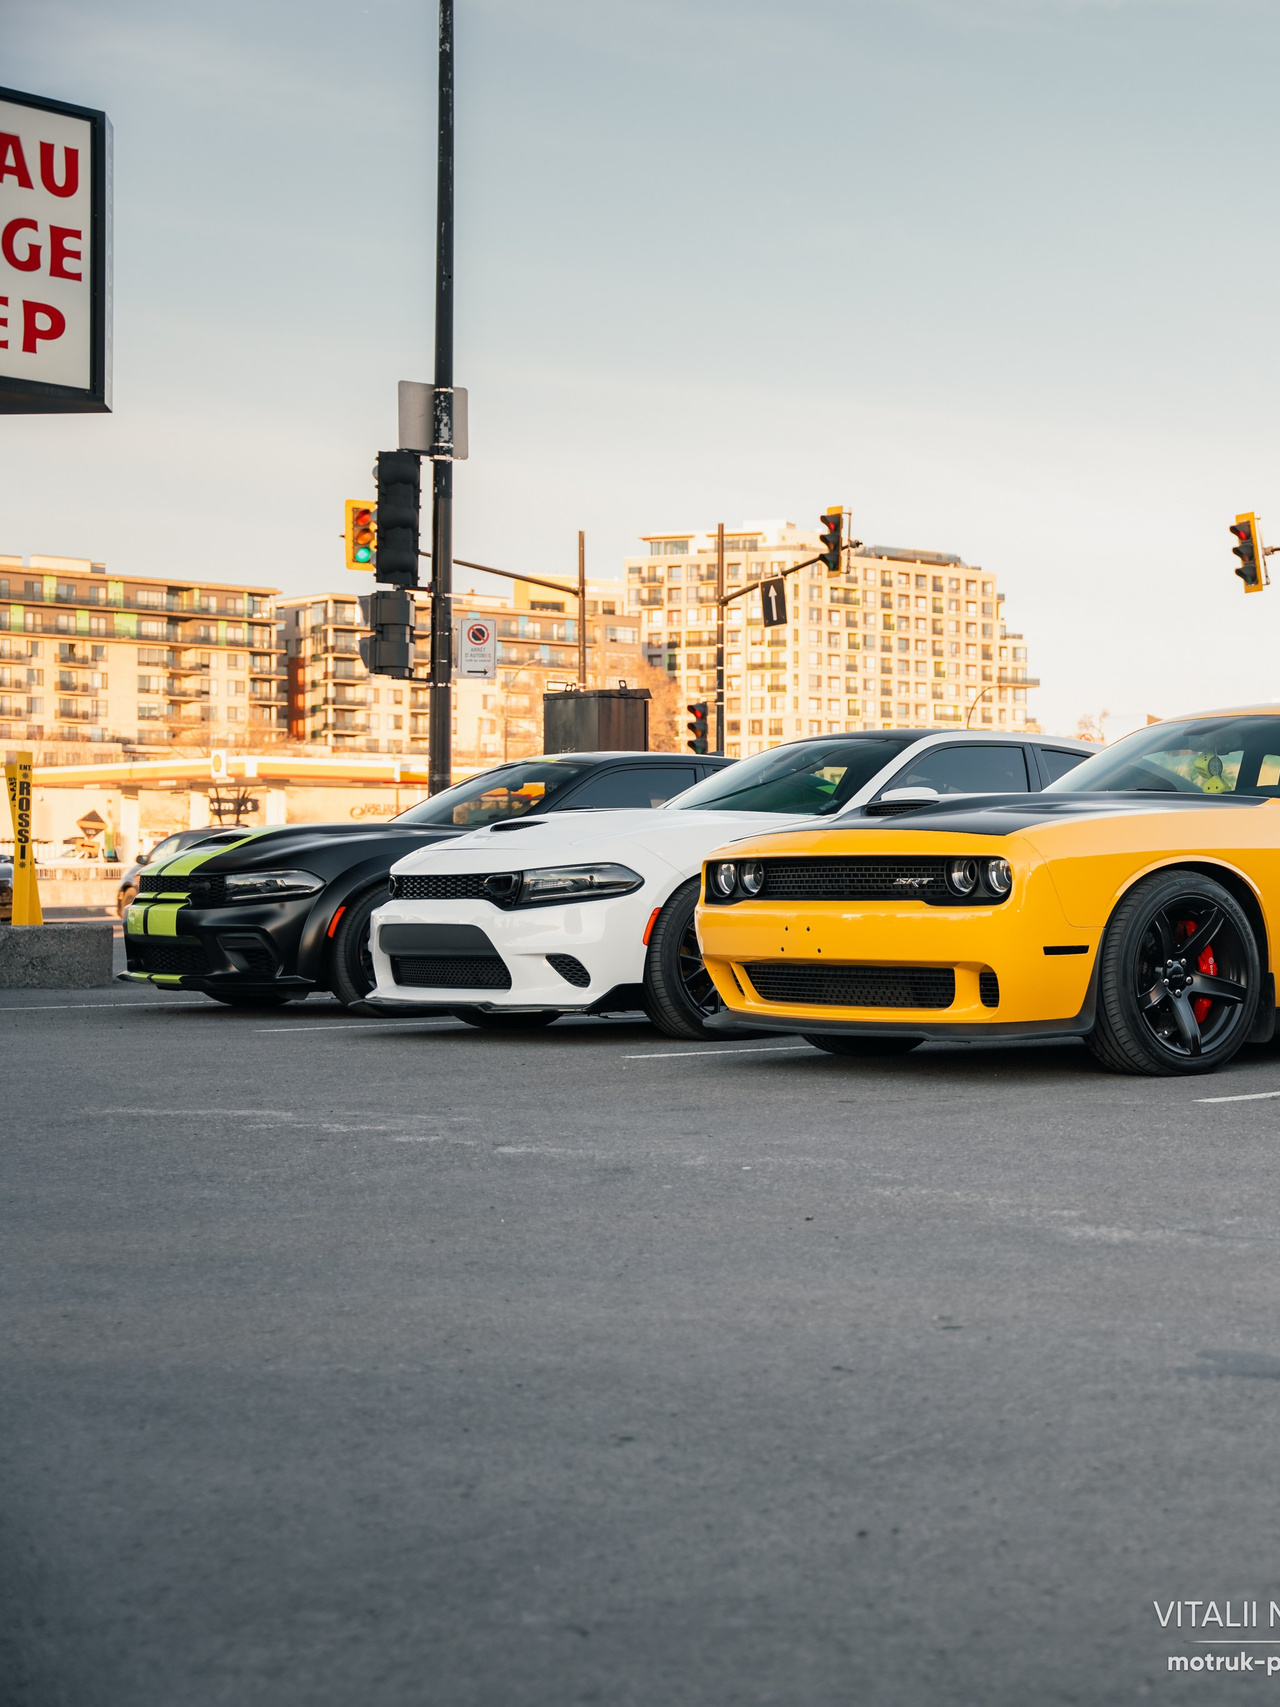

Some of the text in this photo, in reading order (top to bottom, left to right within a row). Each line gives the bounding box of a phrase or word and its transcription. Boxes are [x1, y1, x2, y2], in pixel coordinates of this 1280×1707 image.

[1, 217, 82, 282] GE
[0, 296, 66, 354] P
[17, 780, 31, 860] ROSSI
[893, 877, 935, 888] SRT
